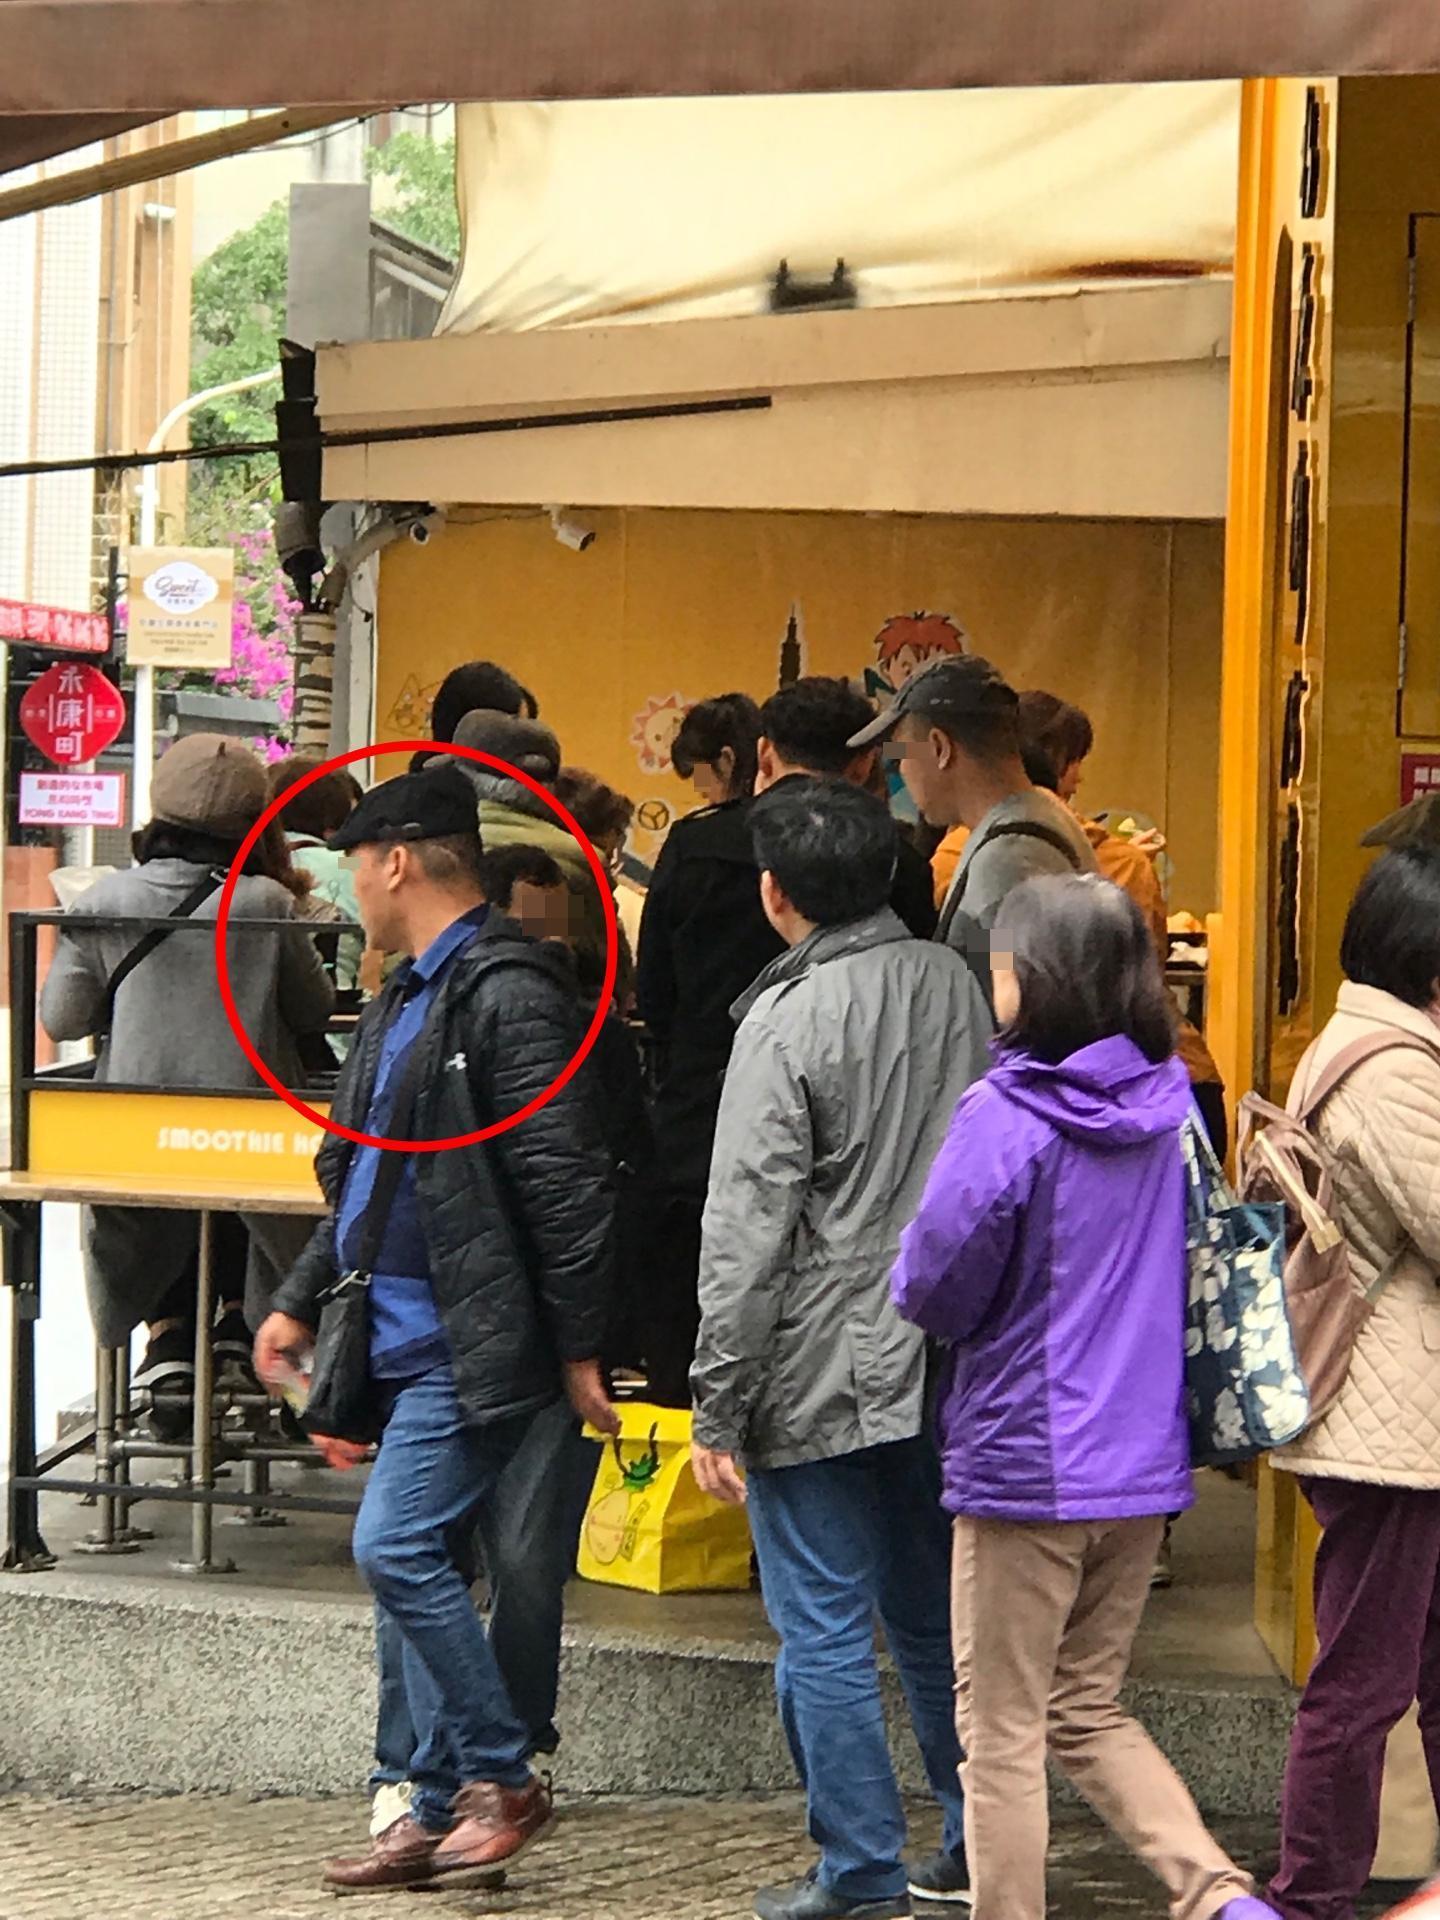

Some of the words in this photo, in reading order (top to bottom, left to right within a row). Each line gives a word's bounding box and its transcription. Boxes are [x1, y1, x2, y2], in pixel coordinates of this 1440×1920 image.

[56, 666, 84, 761] 永康町
[158, 1127, 284, 1154] SMOOTHIE
